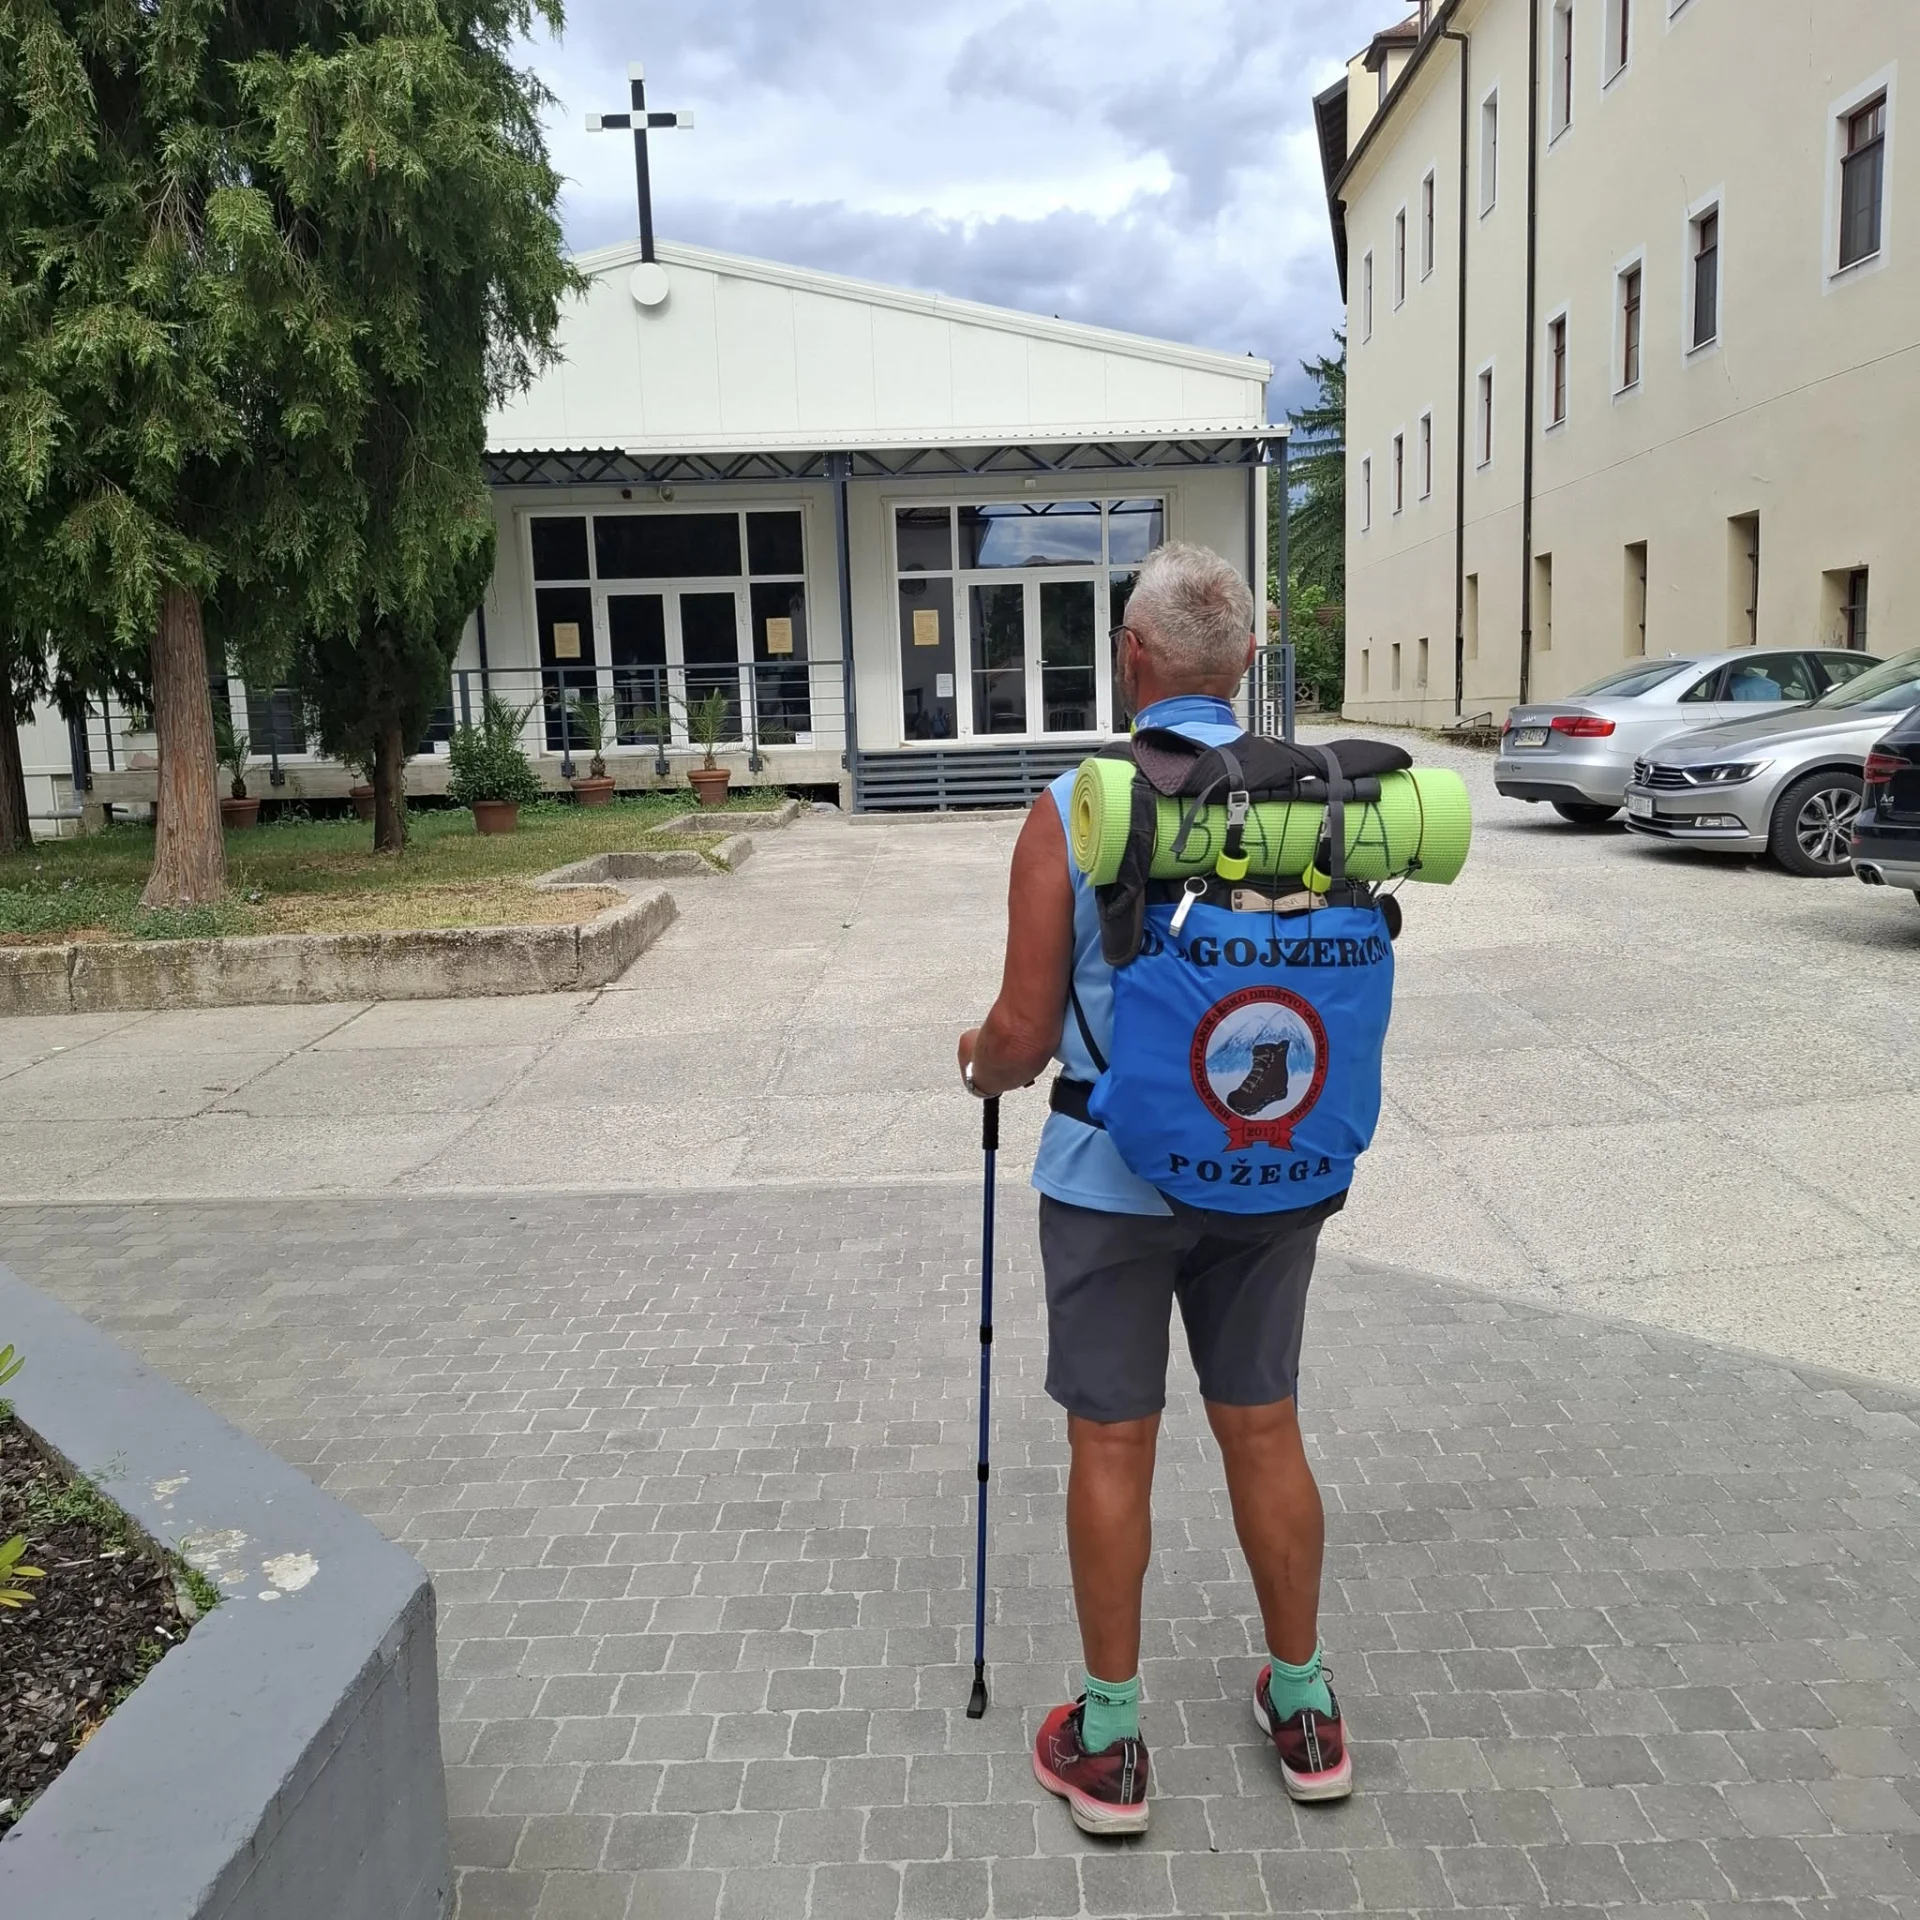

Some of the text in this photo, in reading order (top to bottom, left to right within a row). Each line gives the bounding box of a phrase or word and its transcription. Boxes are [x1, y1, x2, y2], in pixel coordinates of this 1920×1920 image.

[1249, 987, 1303, 1010] DRUŠTVO
[1246, 1126, 1277, 1138] 2017
[1168, 1153, 1333, 1187] POŽEGA
